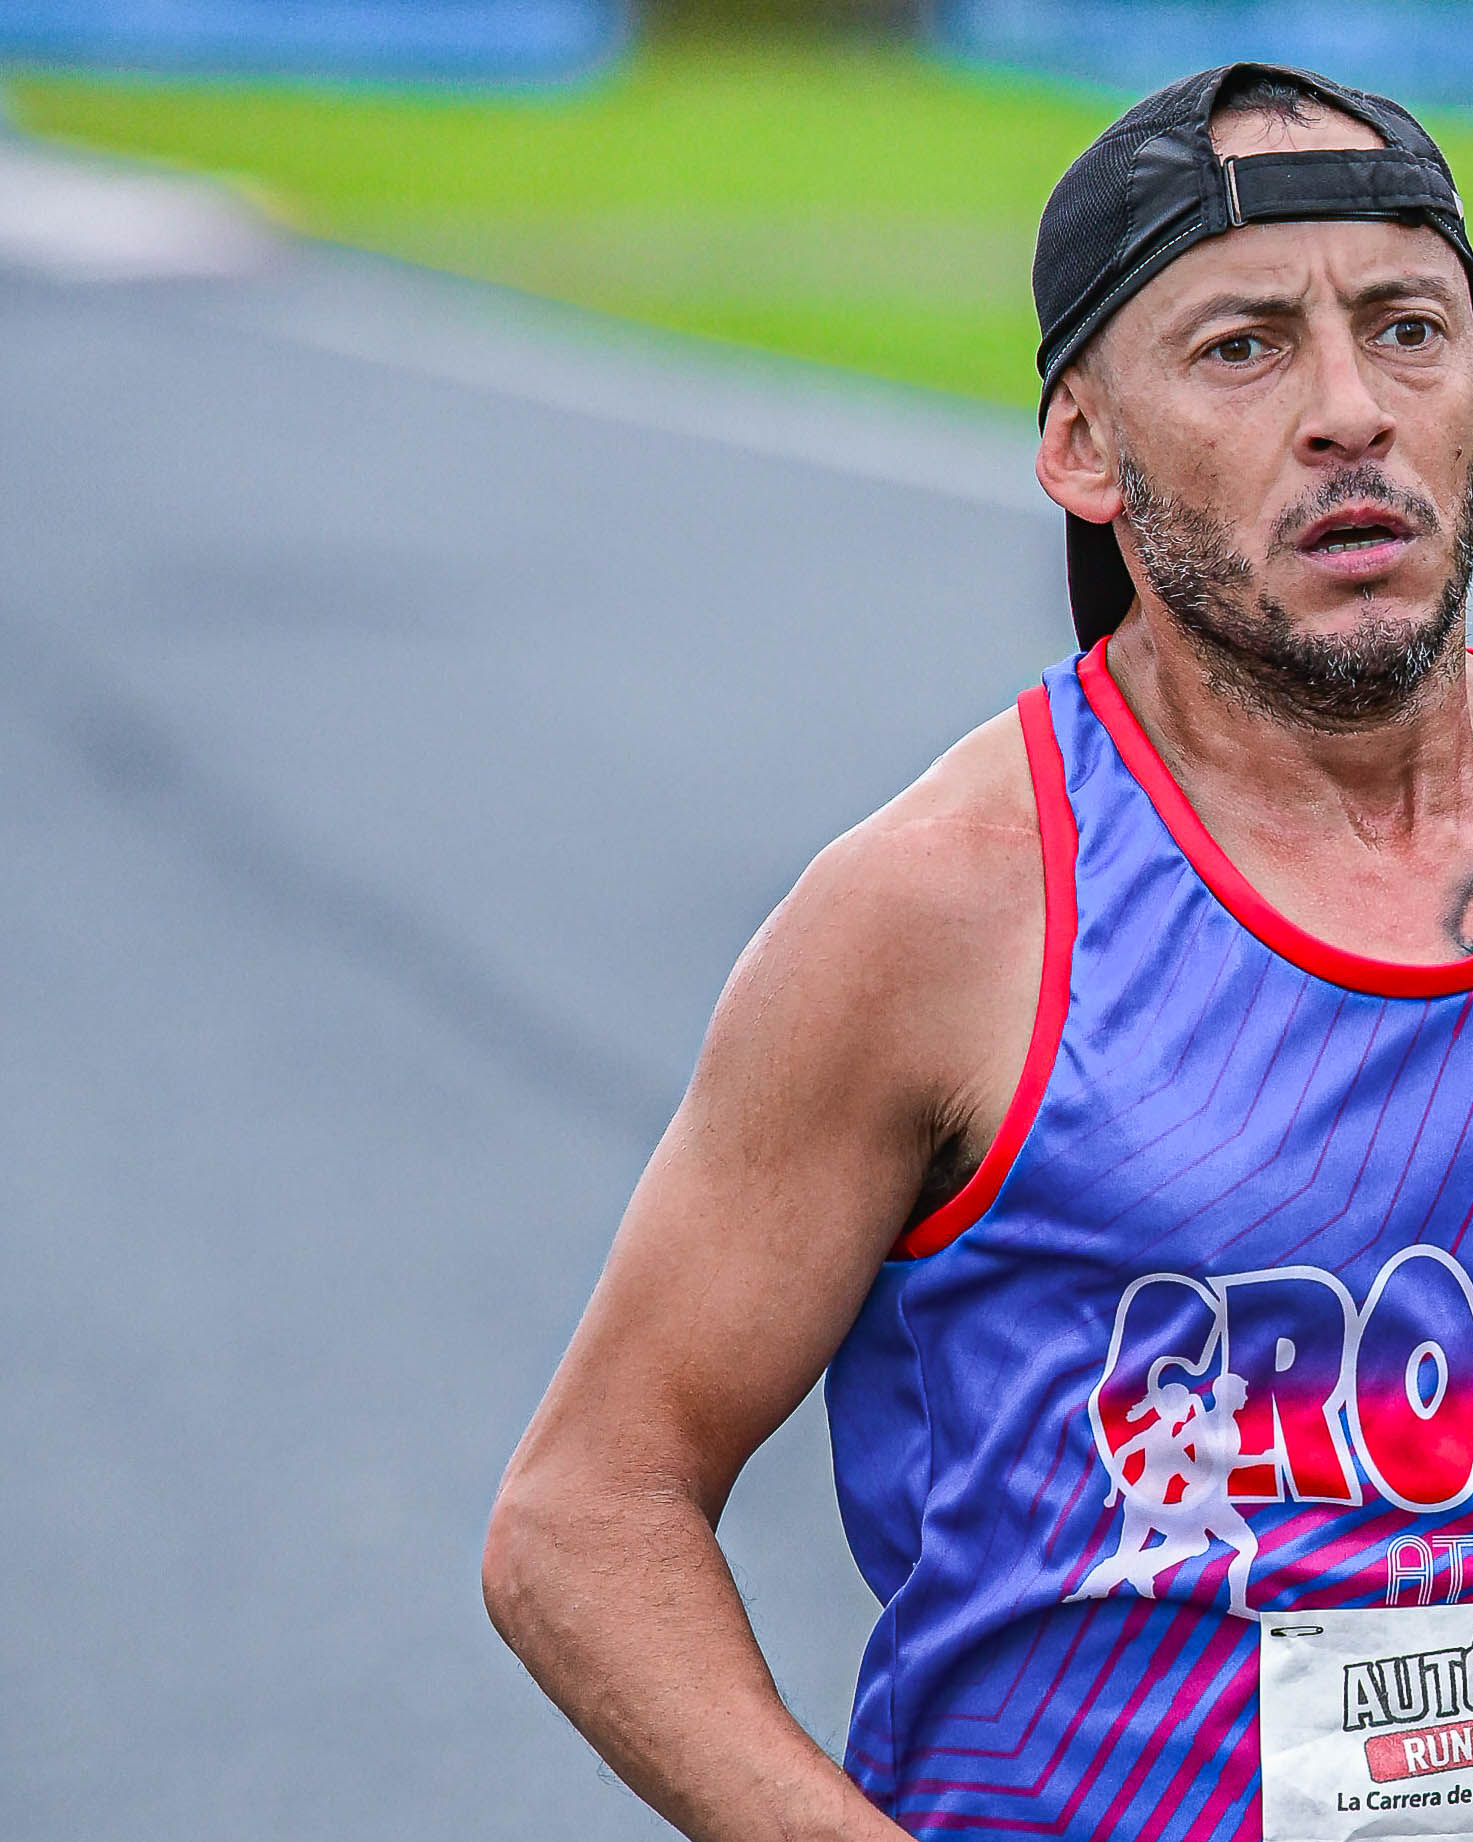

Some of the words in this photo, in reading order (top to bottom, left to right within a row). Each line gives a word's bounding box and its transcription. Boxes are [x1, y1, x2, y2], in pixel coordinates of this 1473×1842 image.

[1336, 1792, 1361, 1812] La
[1366, 1789, 1442, 1811] Carrera
[1447, 1784, 1473, 1805] de
